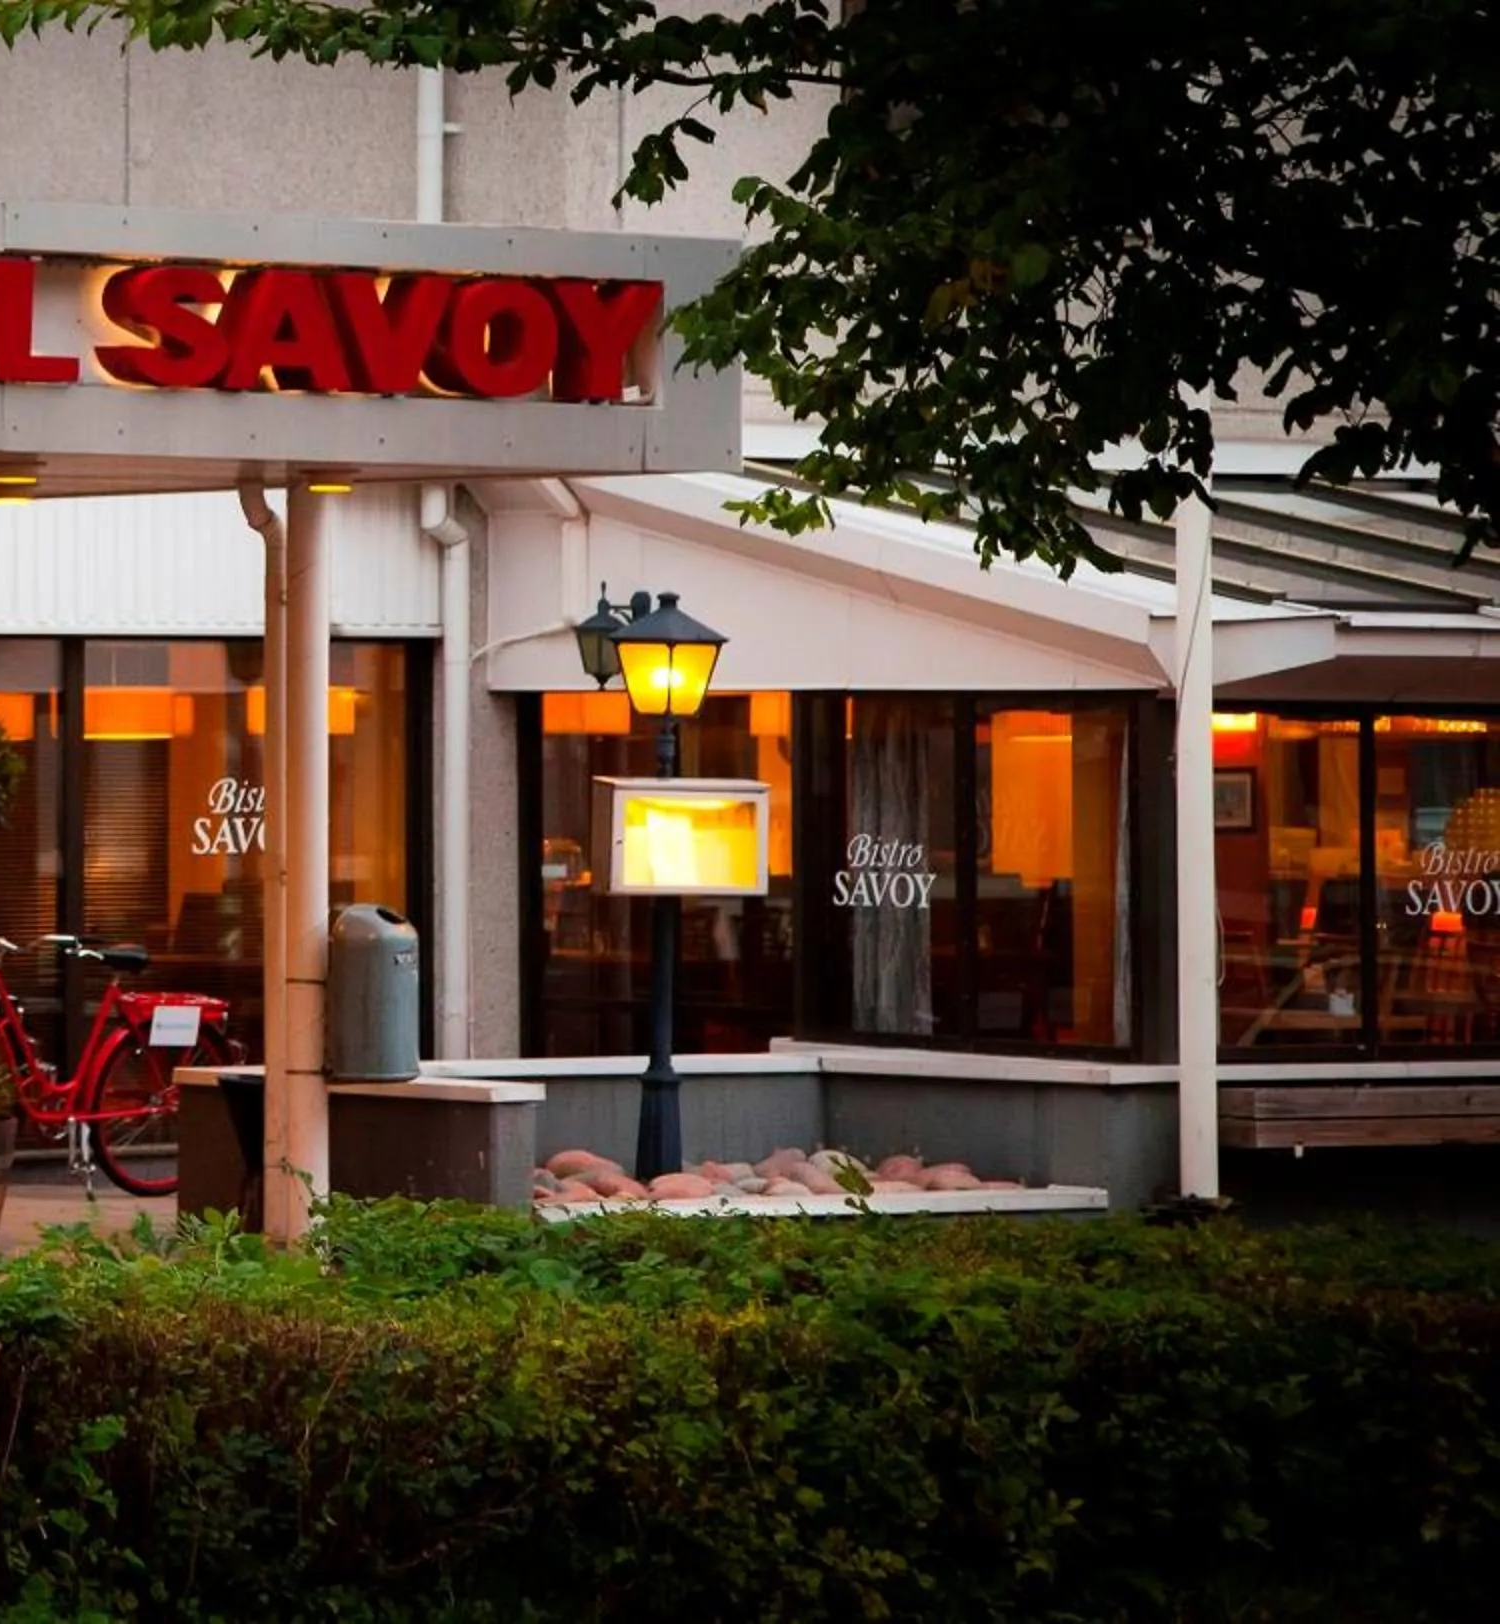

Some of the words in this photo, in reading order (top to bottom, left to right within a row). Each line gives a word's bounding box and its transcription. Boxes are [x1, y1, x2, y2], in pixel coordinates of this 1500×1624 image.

[94, 264, 663, 404] SAVOY
[847, 833, 923, 868] Bistro
[833, 871, 937, 909] SAVOY
